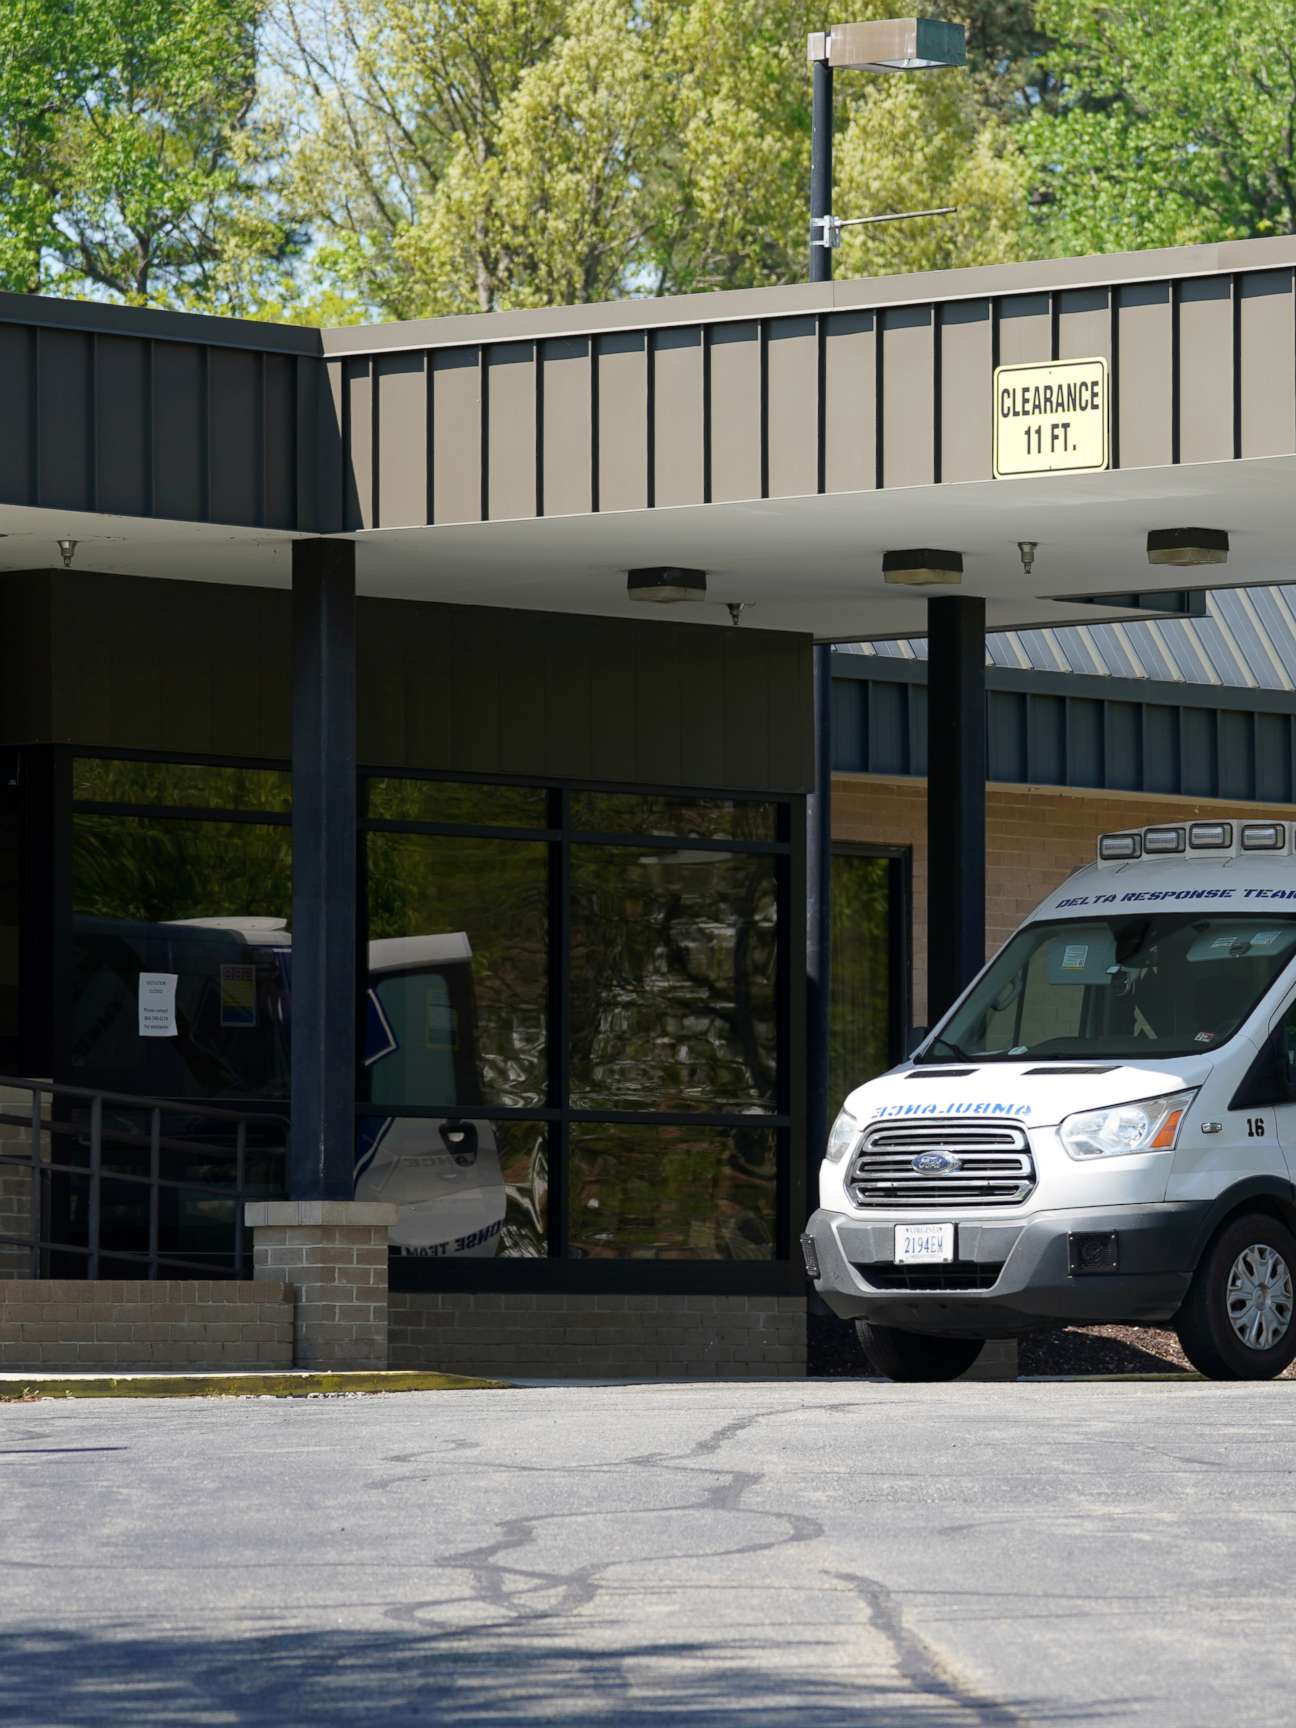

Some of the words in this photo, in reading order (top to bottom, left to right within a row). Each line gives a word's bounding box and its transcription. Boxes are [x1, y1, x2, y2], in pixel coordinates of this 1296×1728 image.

[1000, 380, 1100, 419] CLEARANCE
[1024, 425, 1042, 455] 11
[1050, 422, 1077, 453] FT.
[1055, 893, 1117, 909] DELTA
[1120, 888, 1237, 902] RESPONSE
[1247, 1117, 1265, 1137] 16
[918, 1155, 942, 1170] Ford
